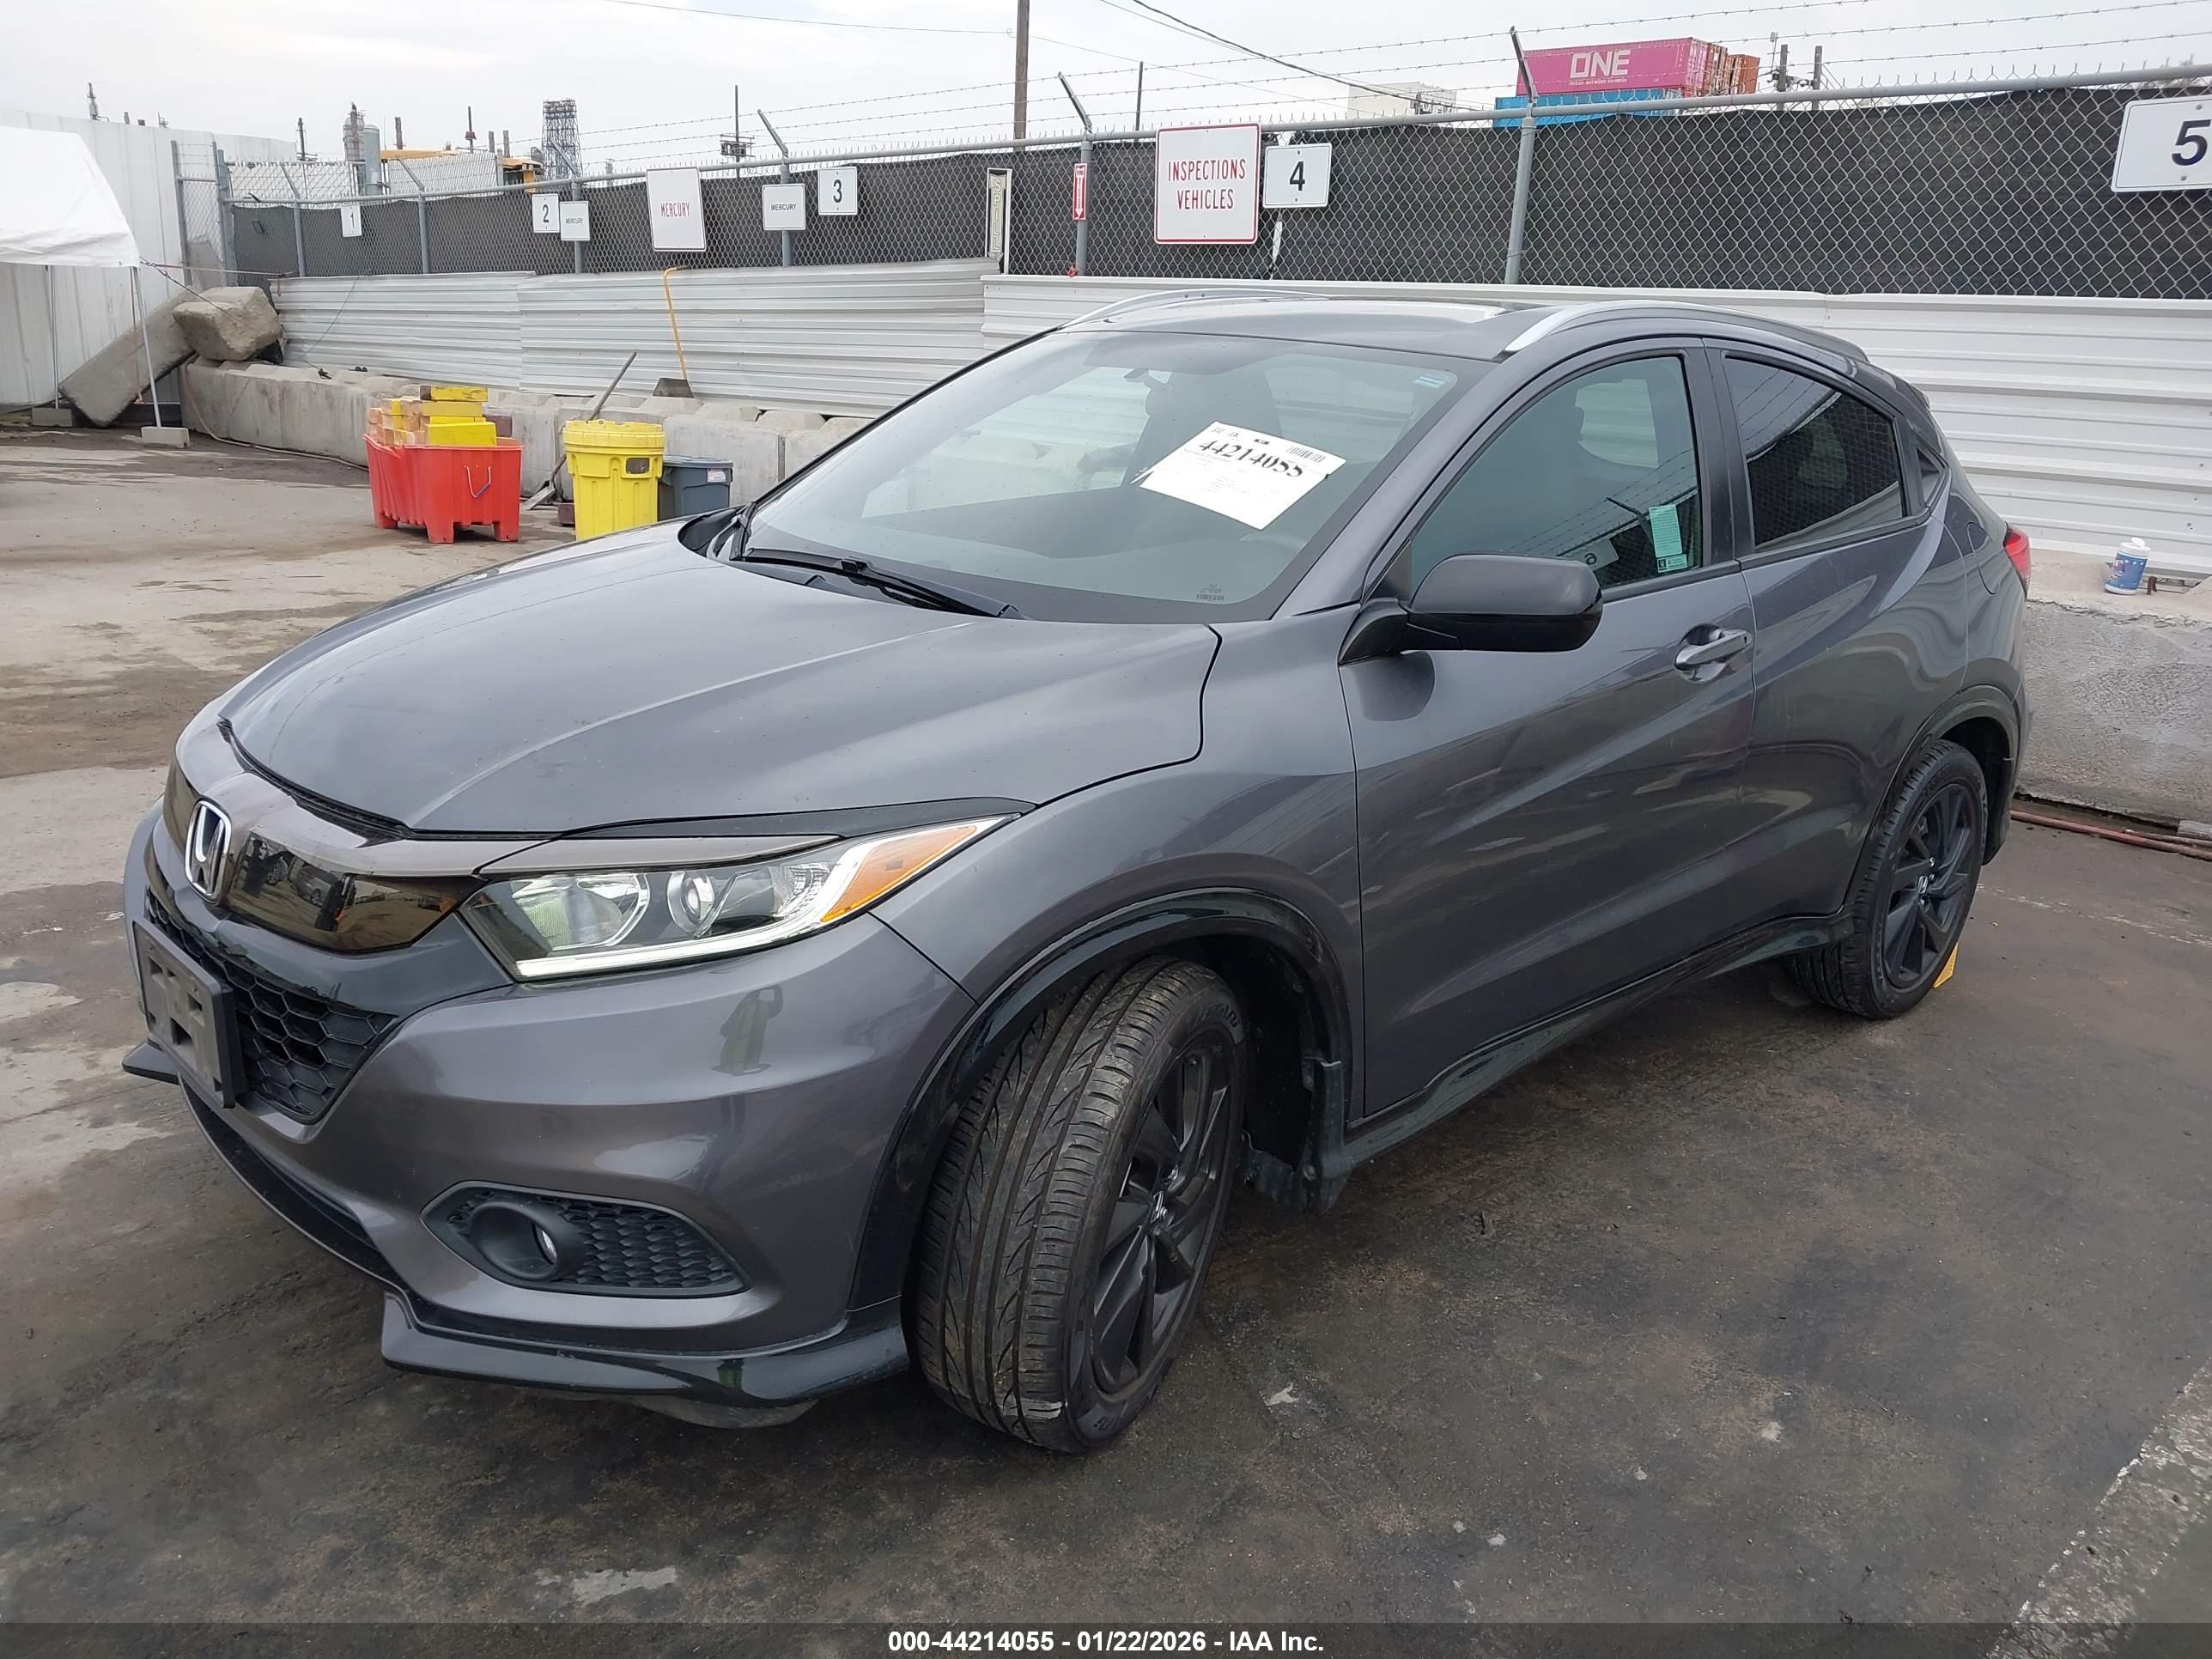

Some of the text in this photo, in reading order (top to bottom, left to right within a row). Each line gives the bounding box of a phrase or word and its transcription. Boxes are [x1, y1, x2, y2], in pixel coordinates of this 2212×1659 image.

[1570, 49, 1631, 78] ONE
[2172, 118, 2212, 166] 5
[1168, 159, 1246, 181] INSPECTIONS
[1289, 161, 1306, 191] 4
[833, 179, 843, 204] 3
[1177, 189, 1234, 210] VEHICLES
[349, 212, 355, 228] 1
[542, 204, 550, 223] 2
[660, 203, 690, 217] MERCURY
[993, 179, 1001, 251] SPILL
